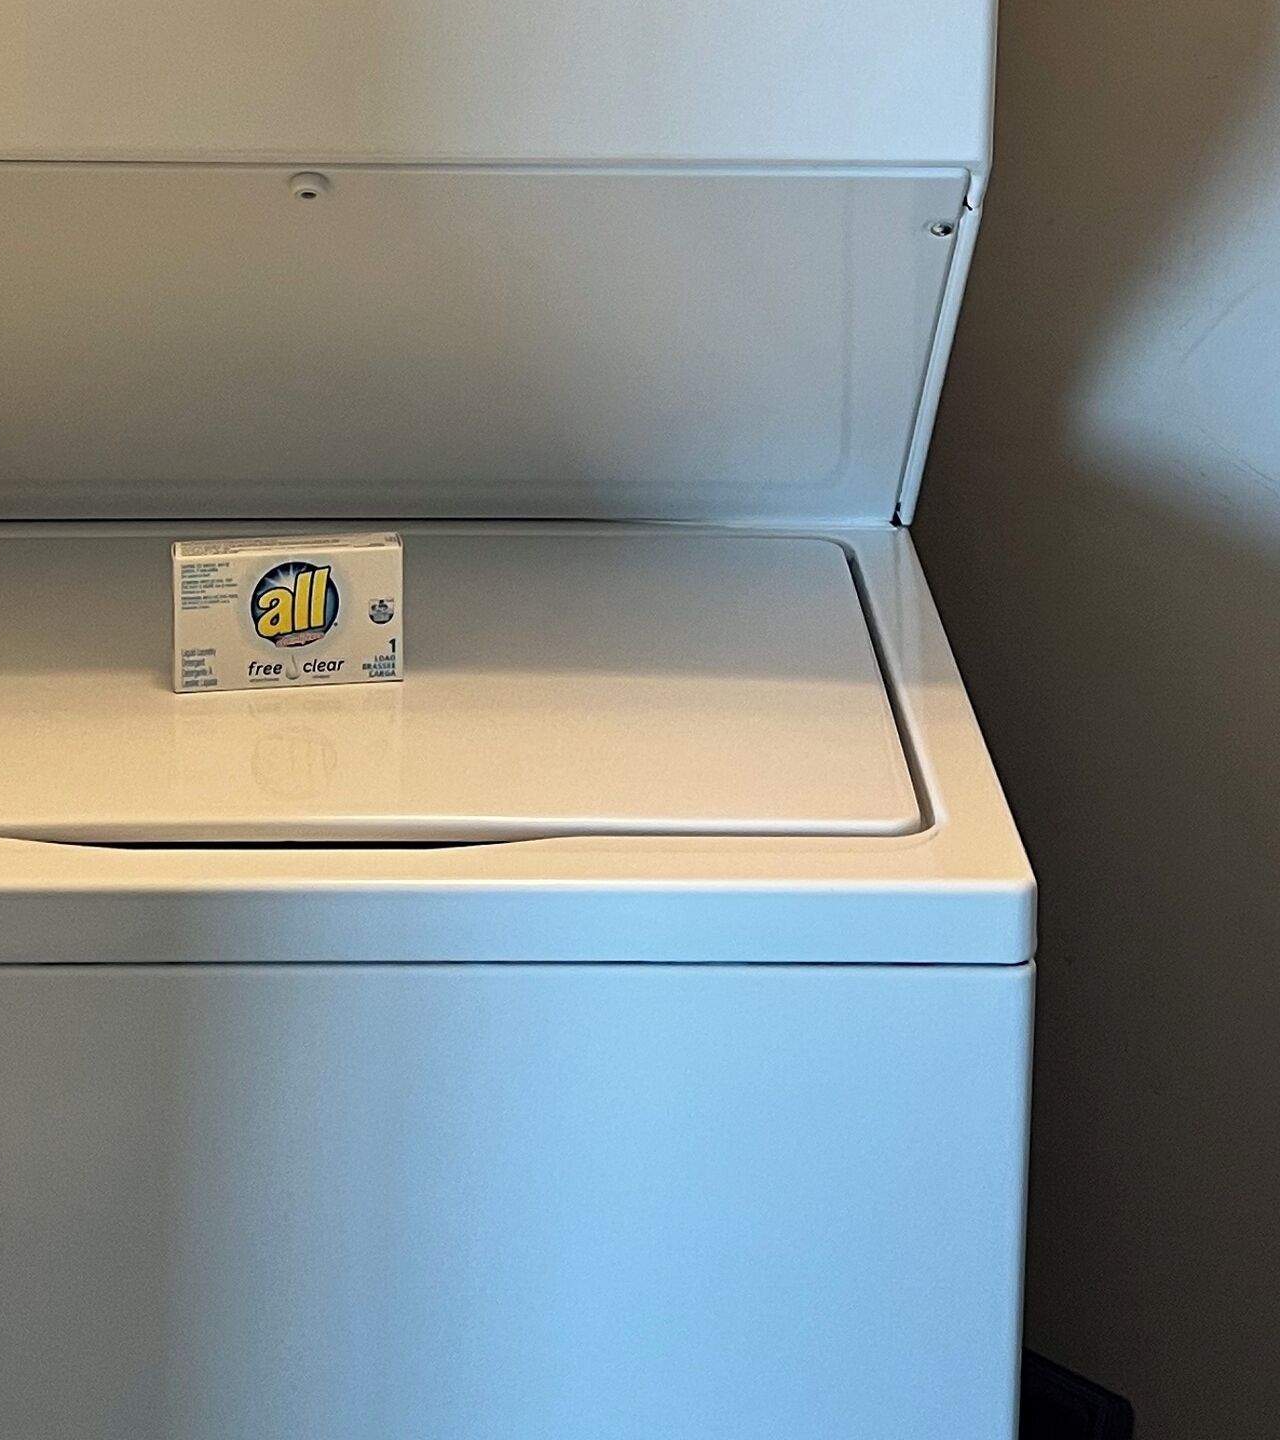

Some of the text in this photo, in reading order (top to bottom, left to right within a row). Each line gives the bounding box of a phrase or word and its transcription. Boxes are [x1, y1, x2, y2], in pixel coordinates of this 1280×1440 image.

[256, 565, 331, 638] all
[388, 638, 397, 653] 1
[248, 659, 345, 676] free clear
